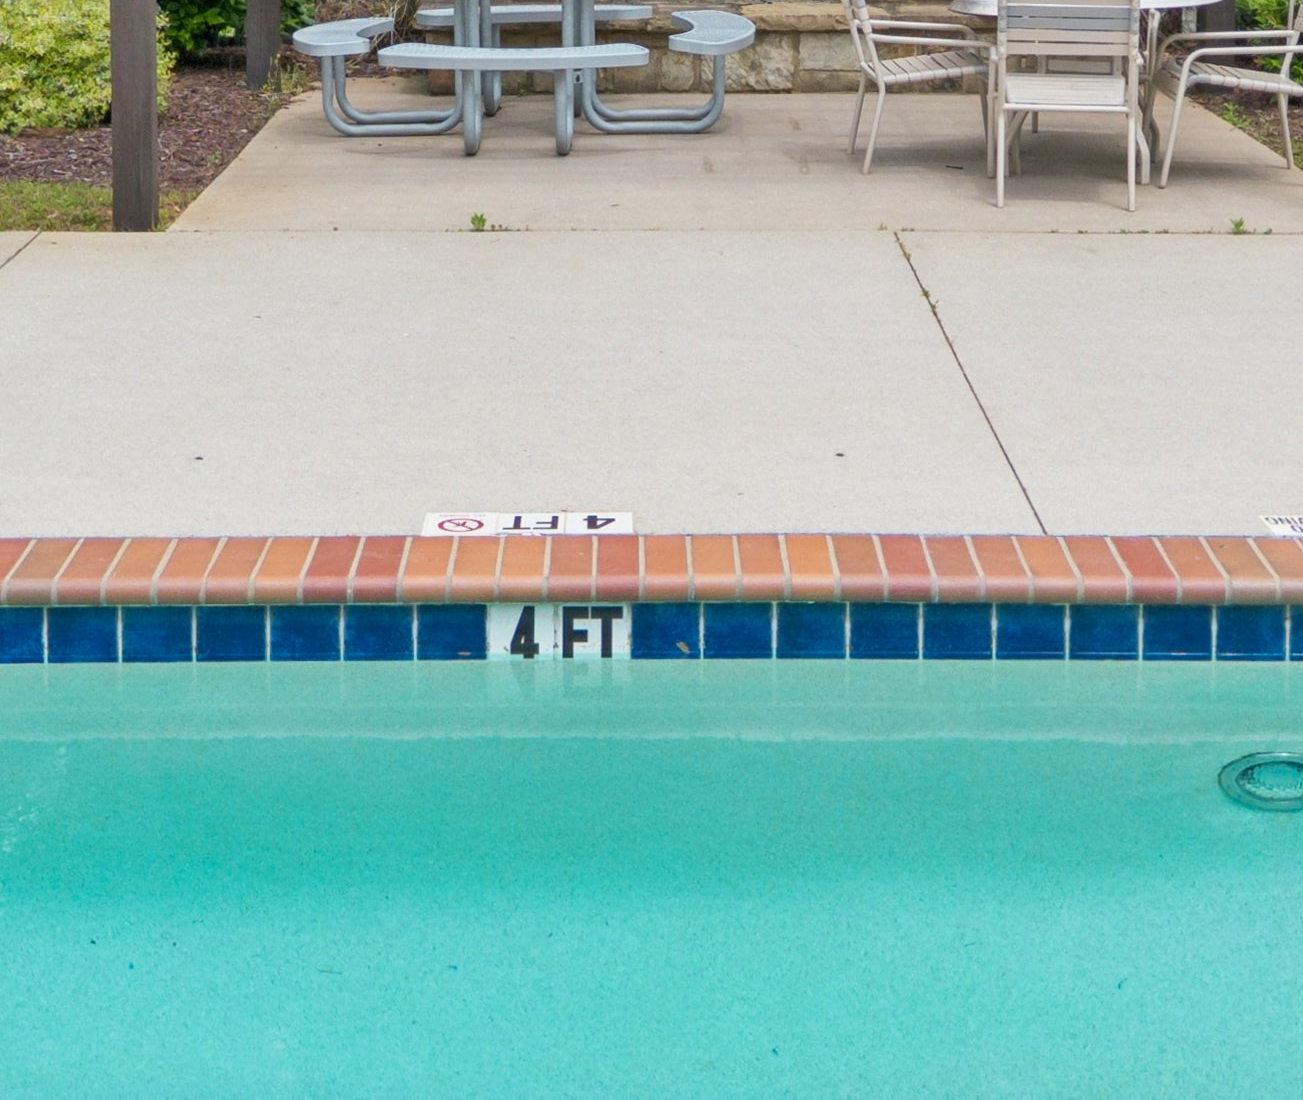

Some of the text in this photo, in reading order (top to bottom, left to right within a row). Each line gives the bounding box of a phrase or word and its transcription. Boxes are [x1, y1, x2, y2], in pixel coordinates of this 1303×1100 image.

[502, 515, 615, 530] 4 FT
[510, 606, 623, 659] 4 FT
